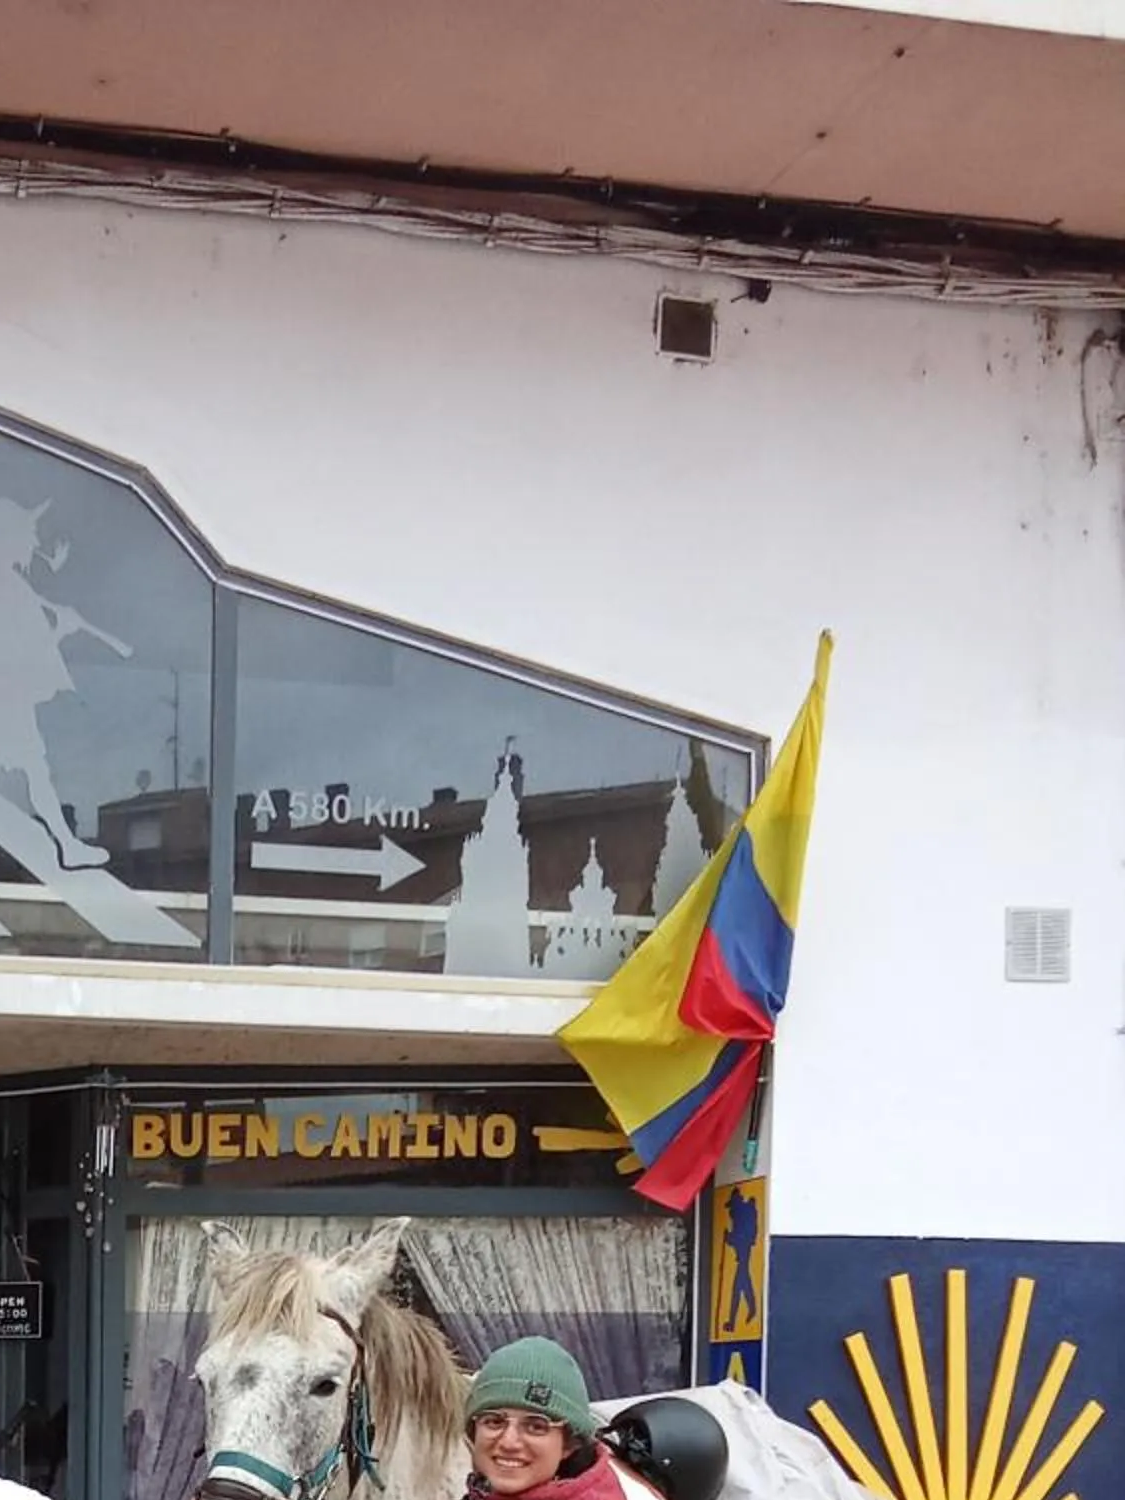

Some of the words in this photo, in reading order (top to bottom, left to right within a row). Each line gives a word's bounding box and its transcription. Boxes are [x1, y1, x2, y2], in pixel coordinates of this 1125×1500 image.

[251, 789, 278, 820] A
[288, 793, 352, 824] 580
[363, 796, 431, 830] Km.
[132, 1113, 280, 1159] BUEN
[293, 1113, 518, 1159] CAMINO
